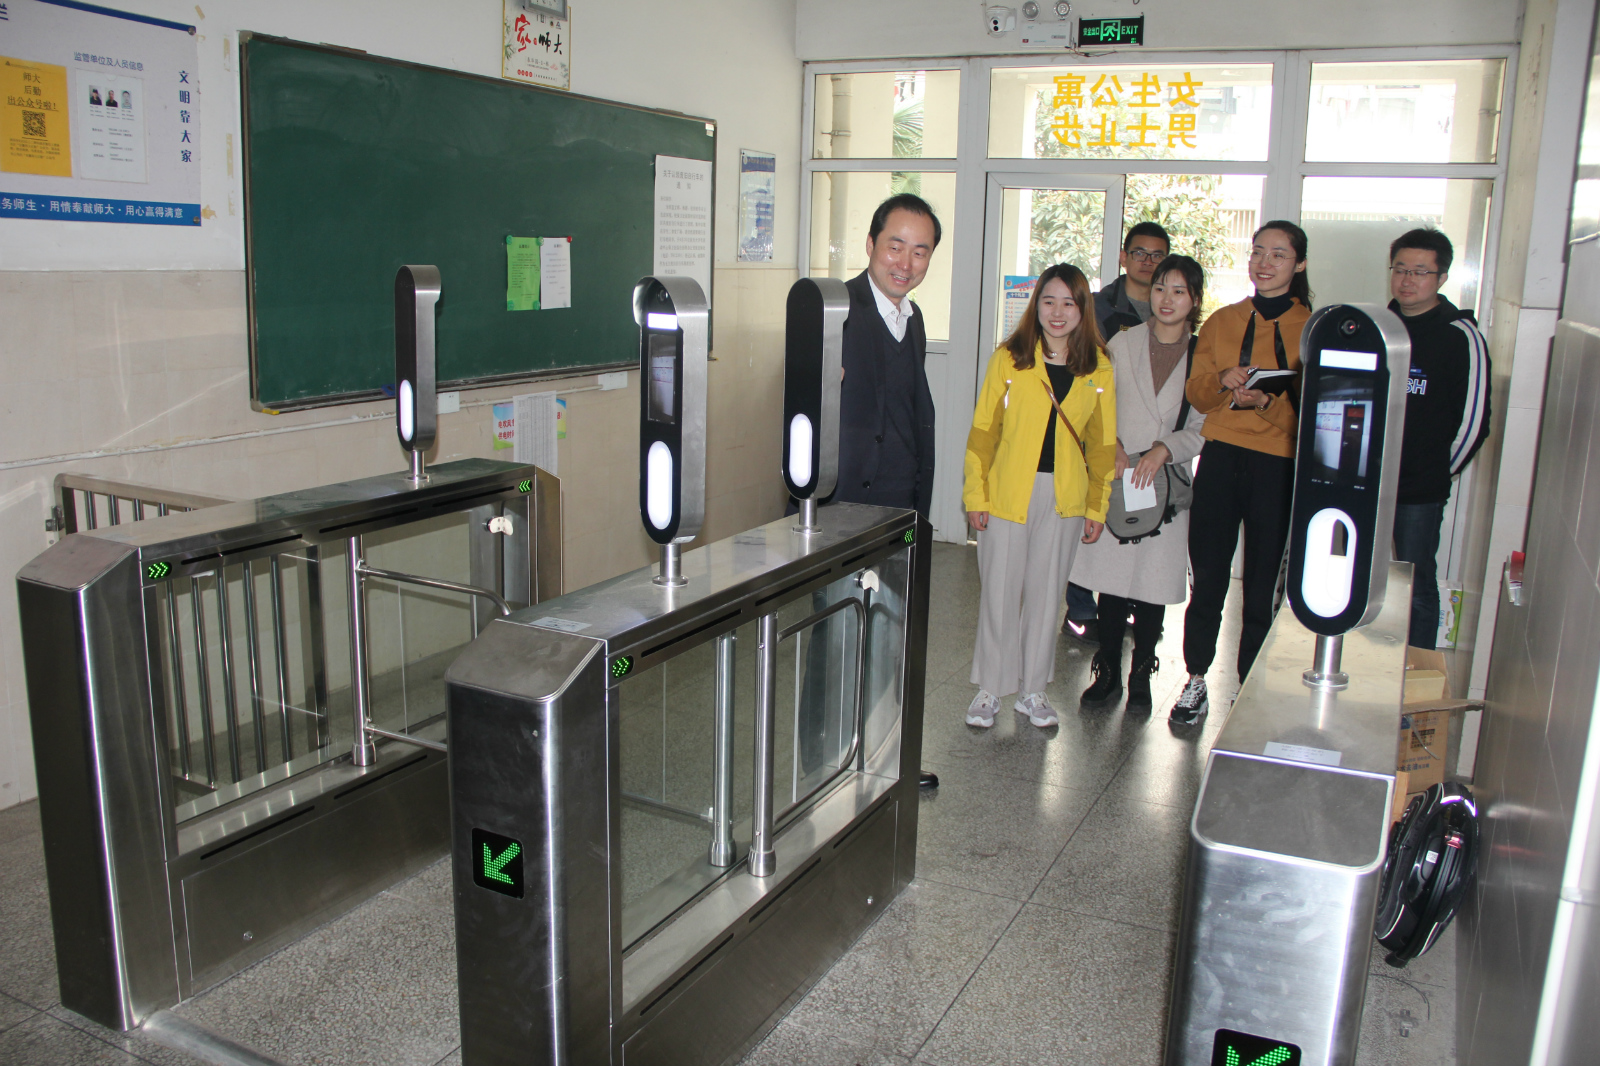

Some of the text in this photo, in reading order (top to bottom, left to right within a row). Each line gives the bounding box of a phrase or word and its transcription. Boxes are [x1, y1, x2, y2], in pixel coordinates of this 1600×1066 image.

[1083, 27, 1100, 36] 安全出口
[1121, 25, 1139, 35] EXIT
[74, 51, 144, 71] 监管单位及人员信息
[23, 72, 41, 83] 师大
[24, 85, 42, 96] 后勤
[178, 70, 192, 163] 文明靠大家
